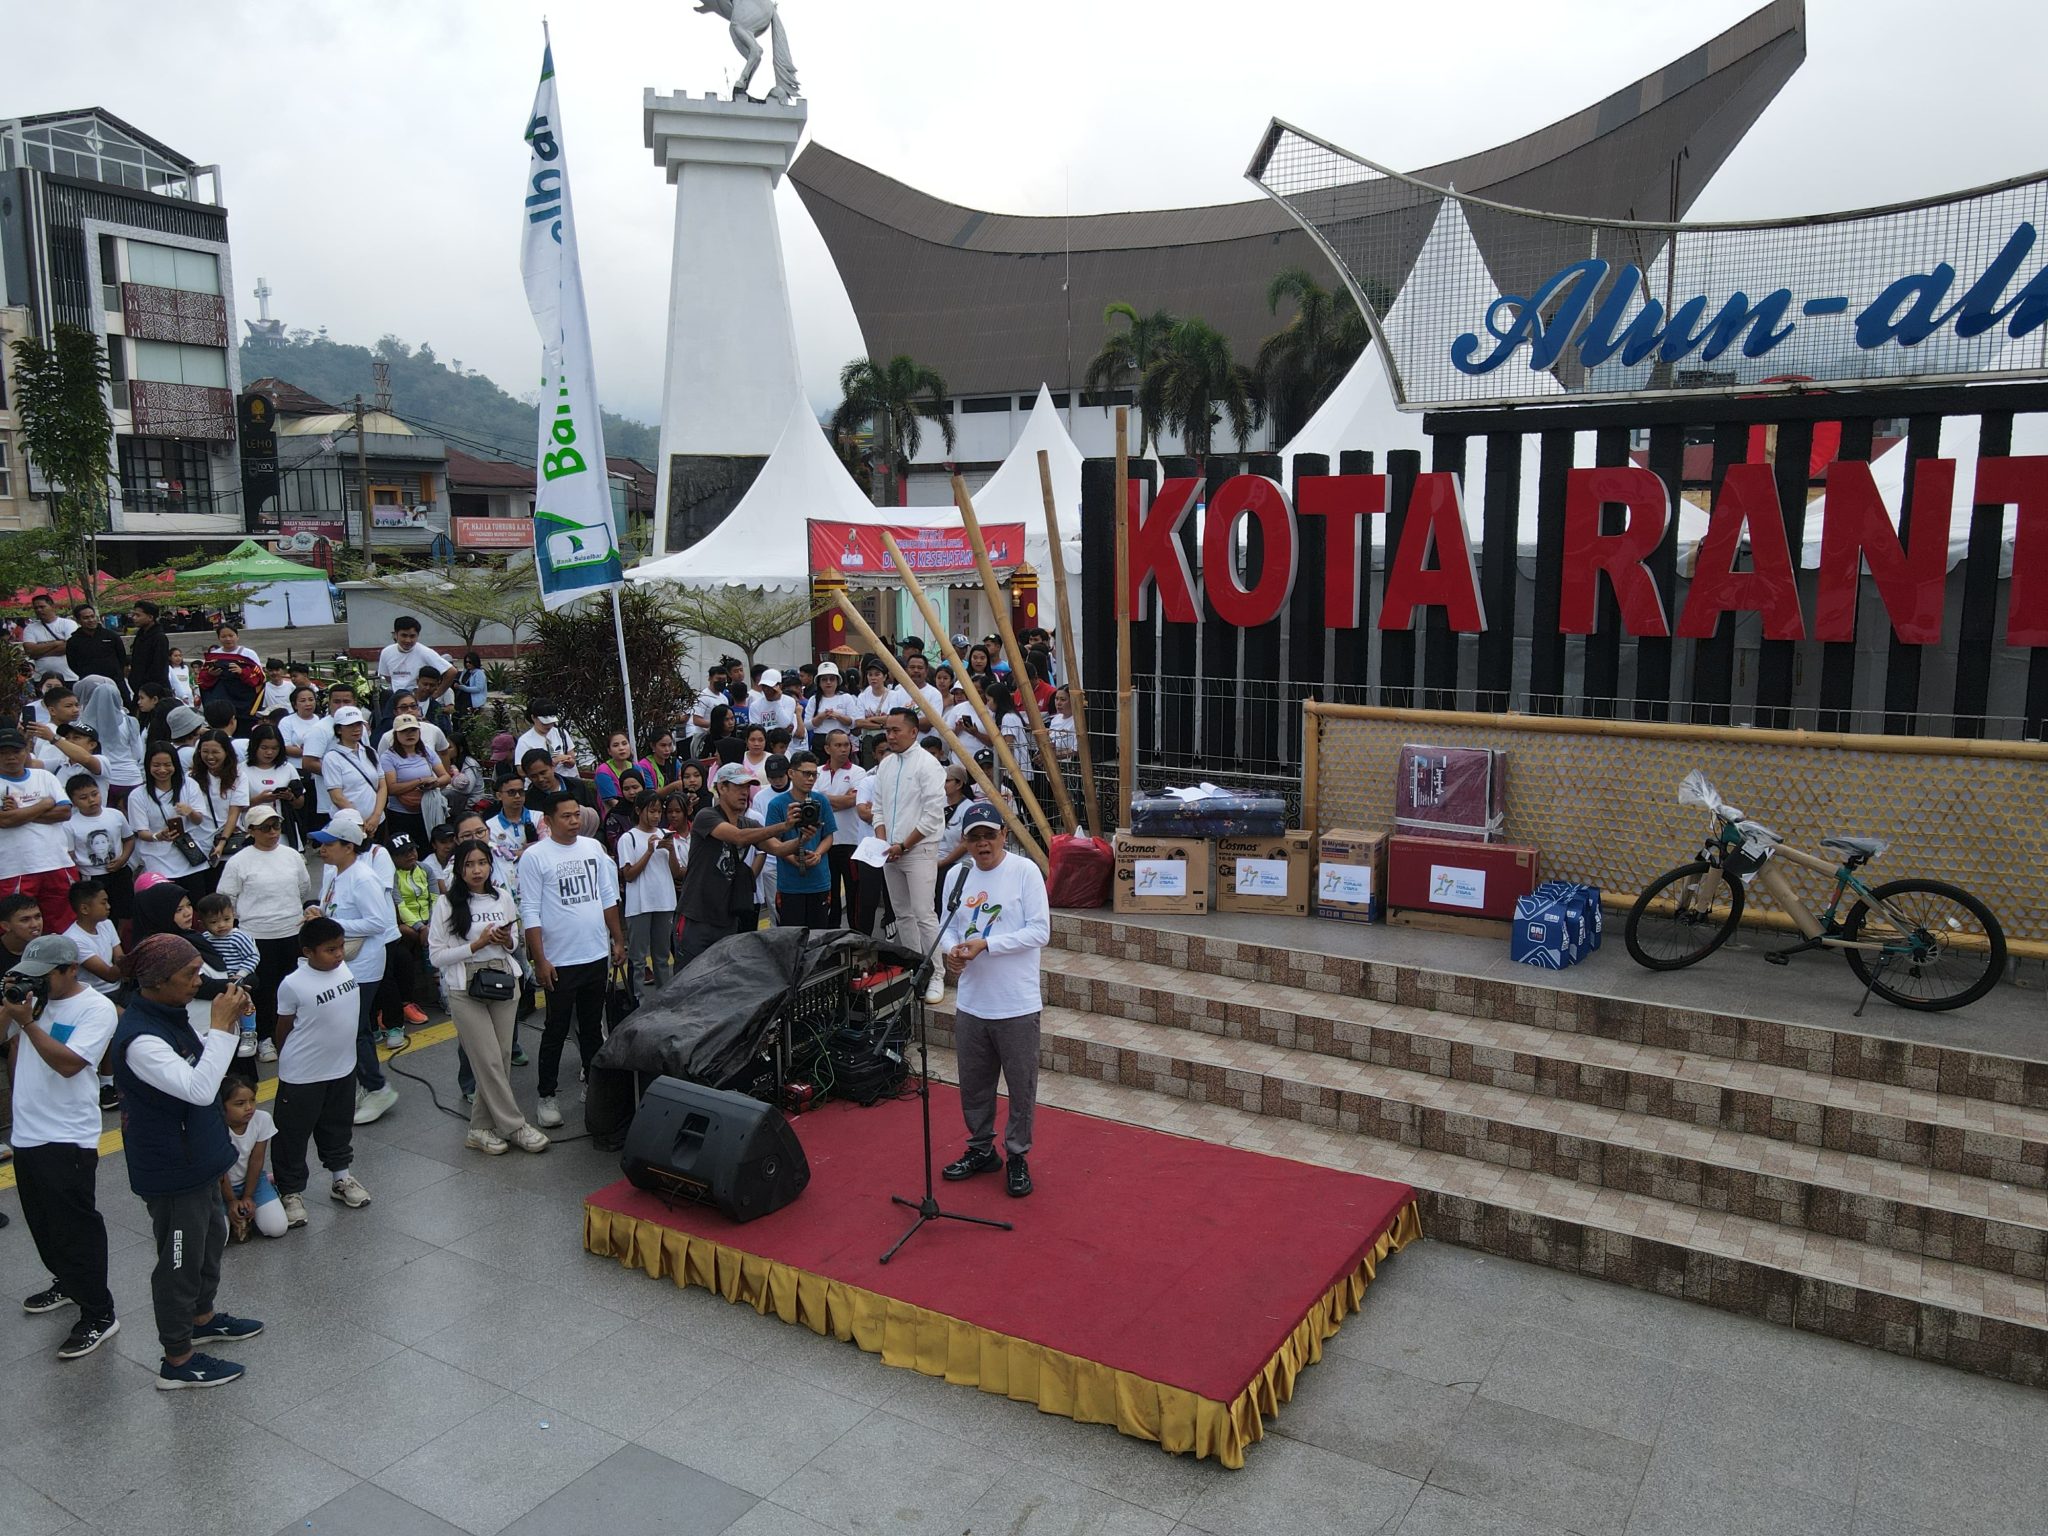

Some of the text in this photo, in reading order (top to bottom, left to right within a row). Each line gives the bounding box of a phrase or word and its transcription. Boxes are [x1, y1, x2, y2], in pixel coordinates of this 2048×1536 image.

[918, 550, 973, 567] KESEHATAN
[1116, 456, 2048, 647] KOTA RANT
[392, 833, 411, 848] NY
[1118, 841, 1157, 853] Cosmos
[1219, 838, 1258, 852] Cosmos
[557, 860, 581, 871] ANTI
[559, 874, 586, 898] HUT
[1530, 926, 1543, 935] BRI
[315, 978, 359, 1007] AIR FOR
[173, 1229, 183, 1270] EIGER
